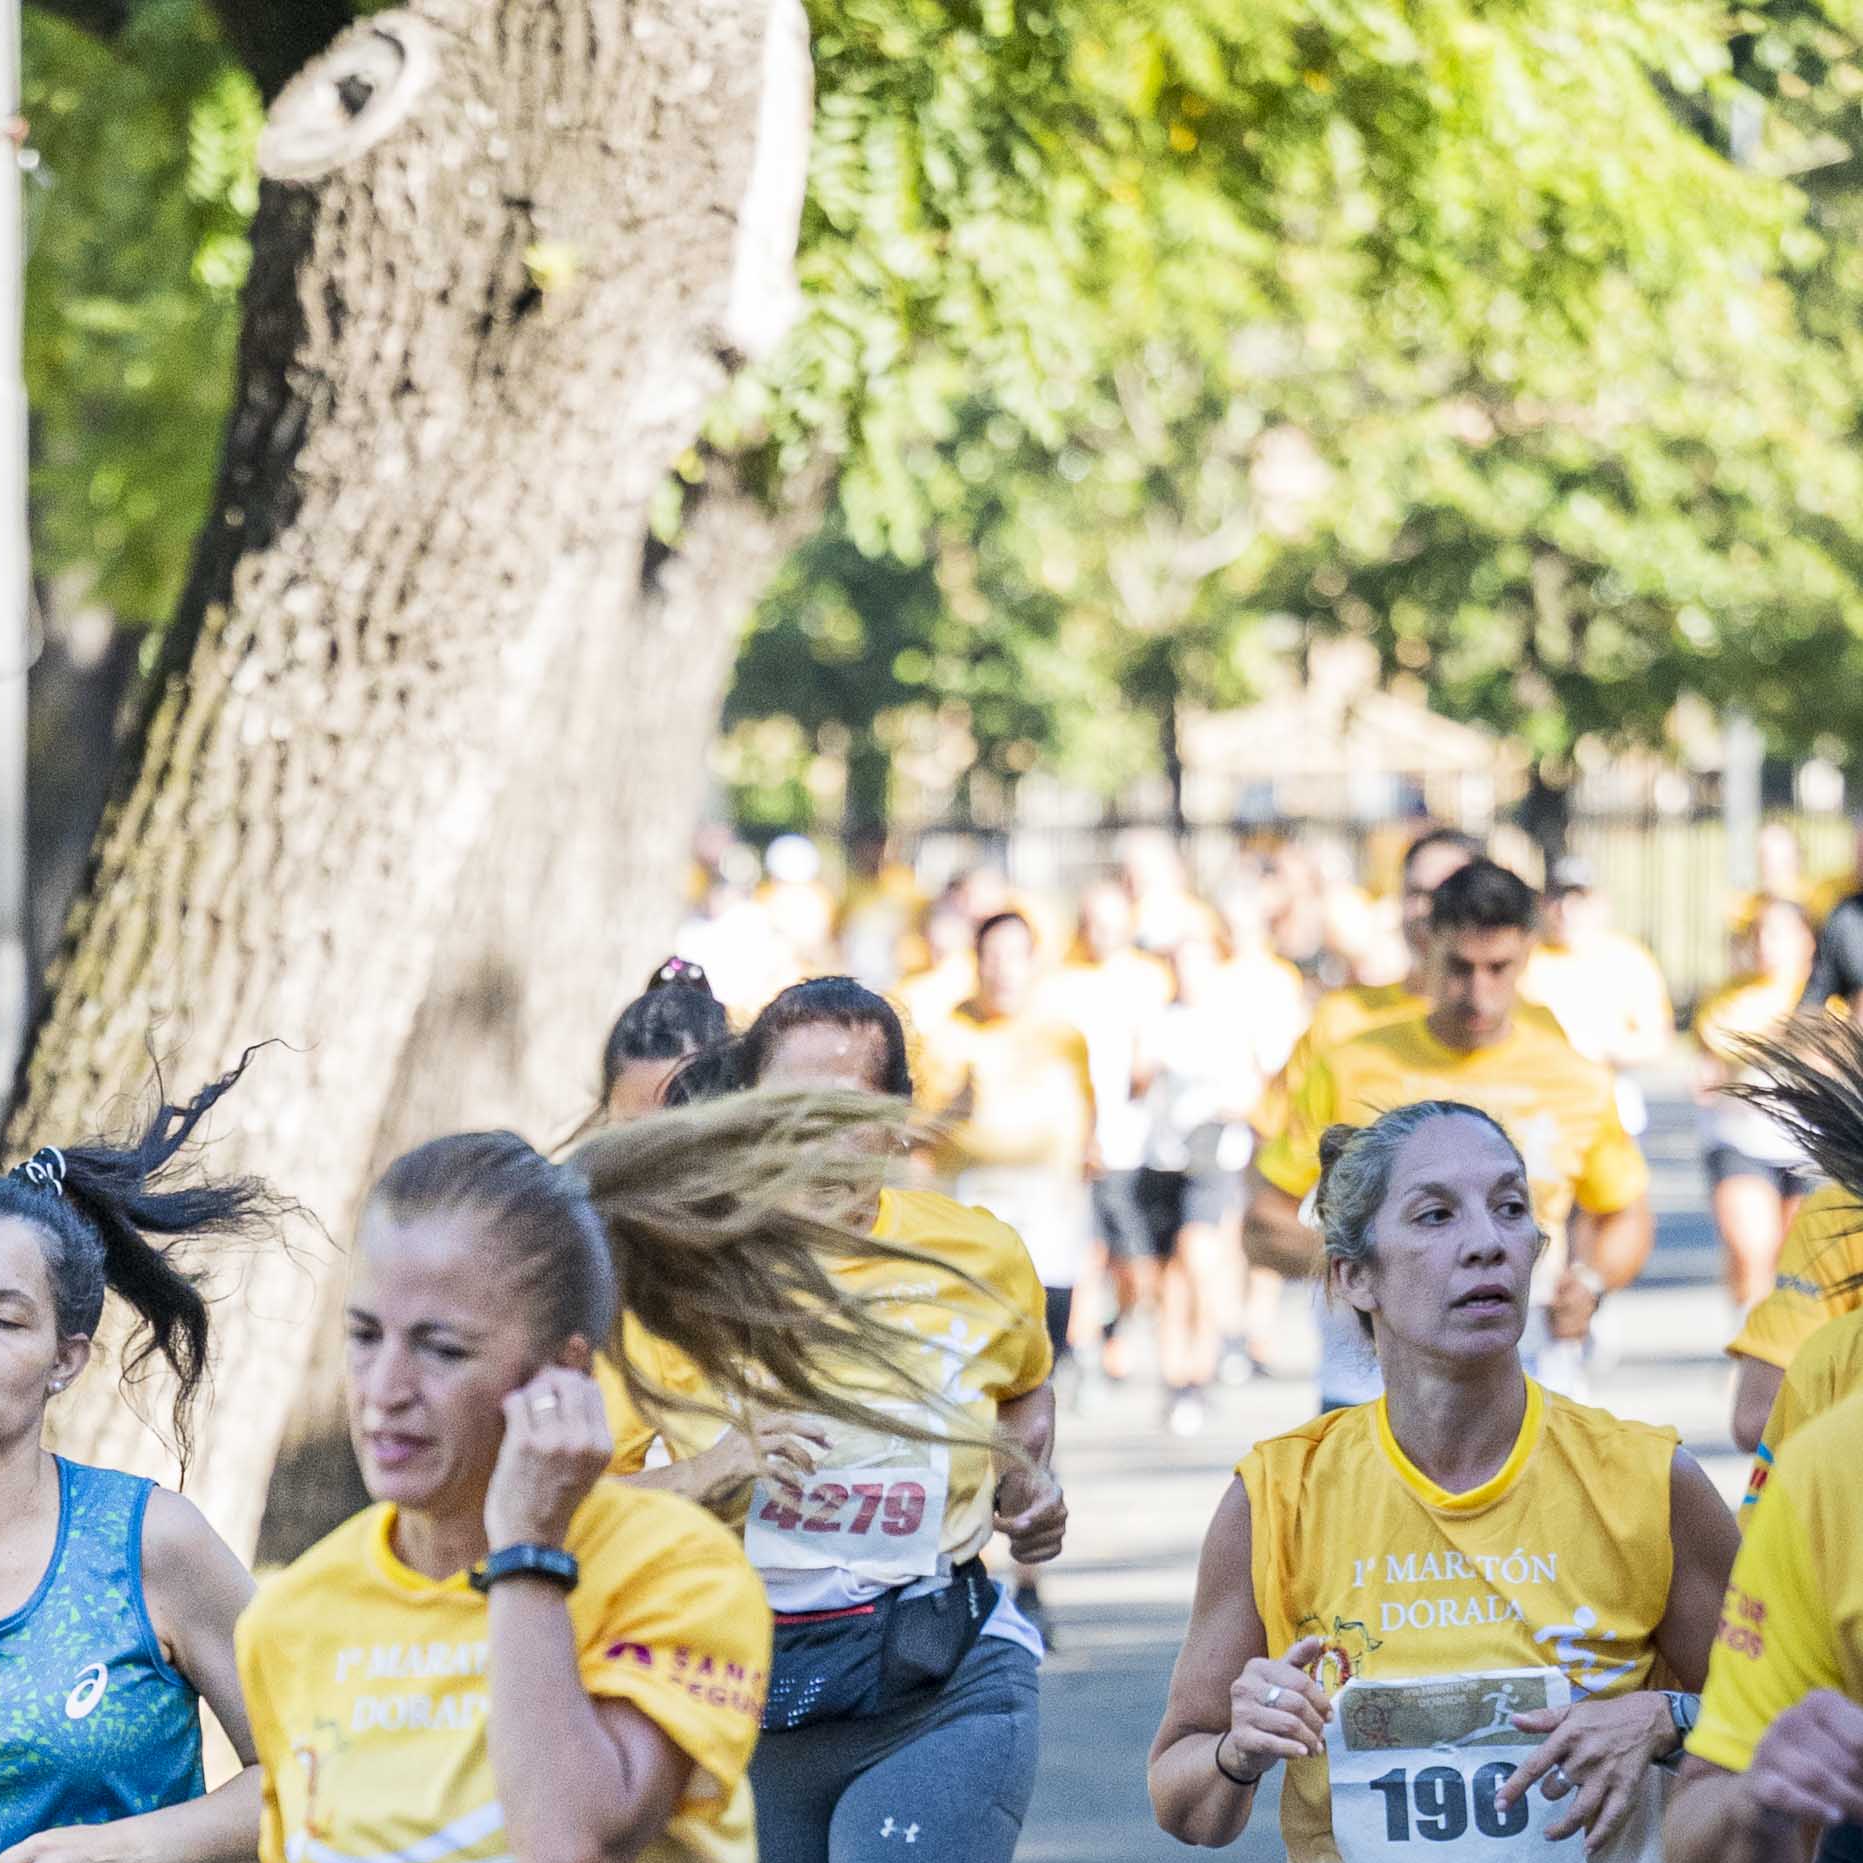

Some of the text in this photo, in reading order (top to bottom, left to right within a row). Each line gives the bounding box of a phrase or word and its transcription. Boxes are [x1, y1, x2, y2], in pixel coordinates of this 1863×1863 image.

[759, 1481, 926, 1536] 4279
[365, 1640, 490, 1682] MARAT
[350, 1692, 490, 1732] DORAD
